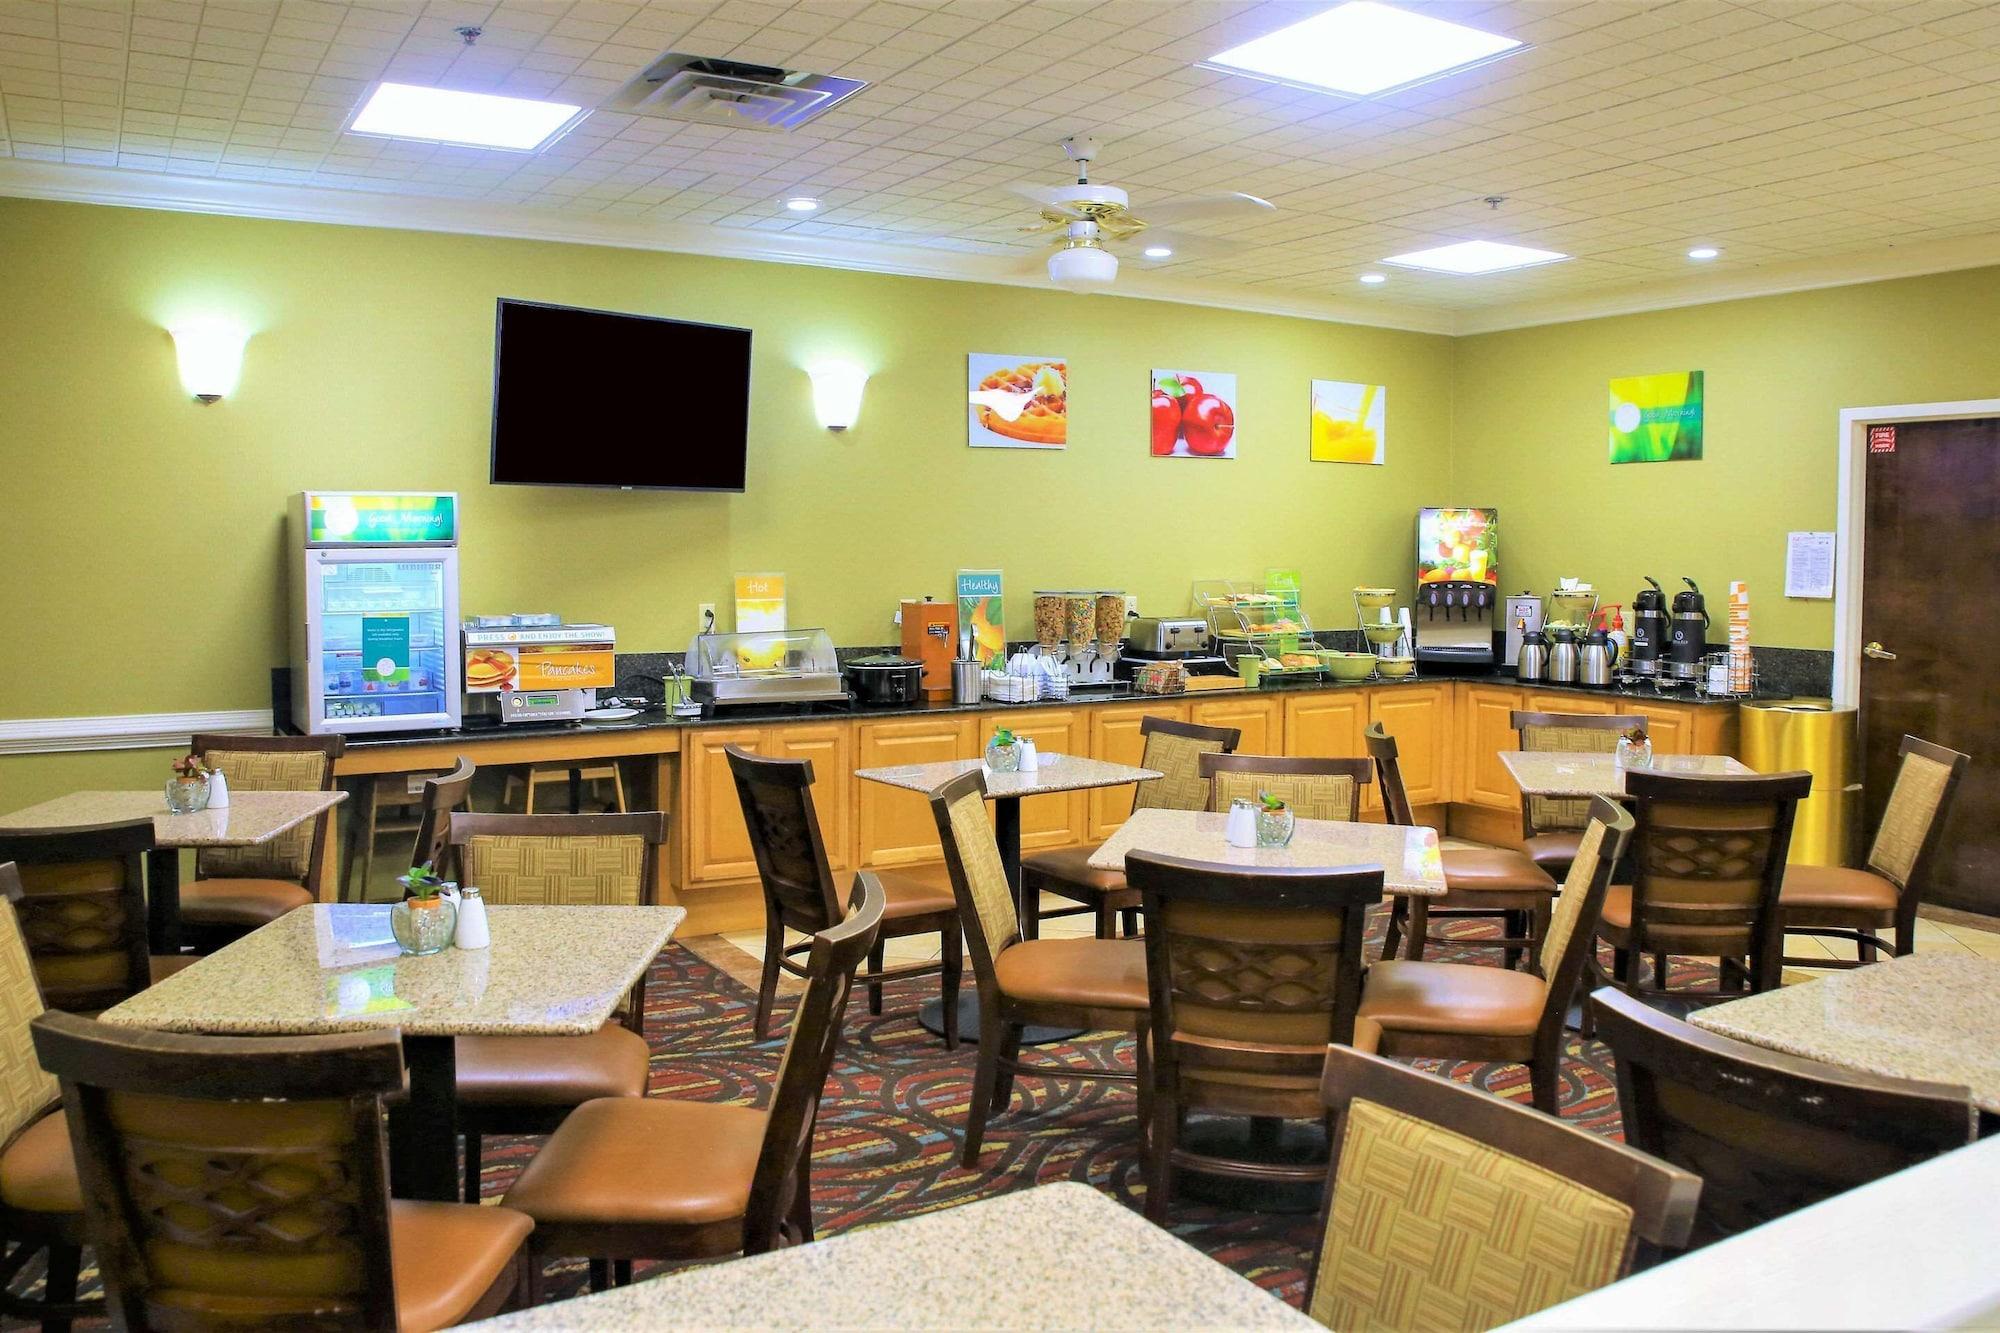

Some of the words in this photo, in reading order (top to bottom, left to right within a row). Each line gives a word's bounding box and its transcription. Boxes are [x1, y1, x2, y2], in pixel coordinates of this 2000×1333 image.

[747, 580, 768, 593] Hot
[962, 577, 999, 594] Healthy
[477, 633, 505, 642] PRESS
[520, 632, 537, 640] AND
[538, 632, 562, 640] ENJOY
[564, 631, 581, 639] THE
[536, 659, 596, 676] Pancakes
